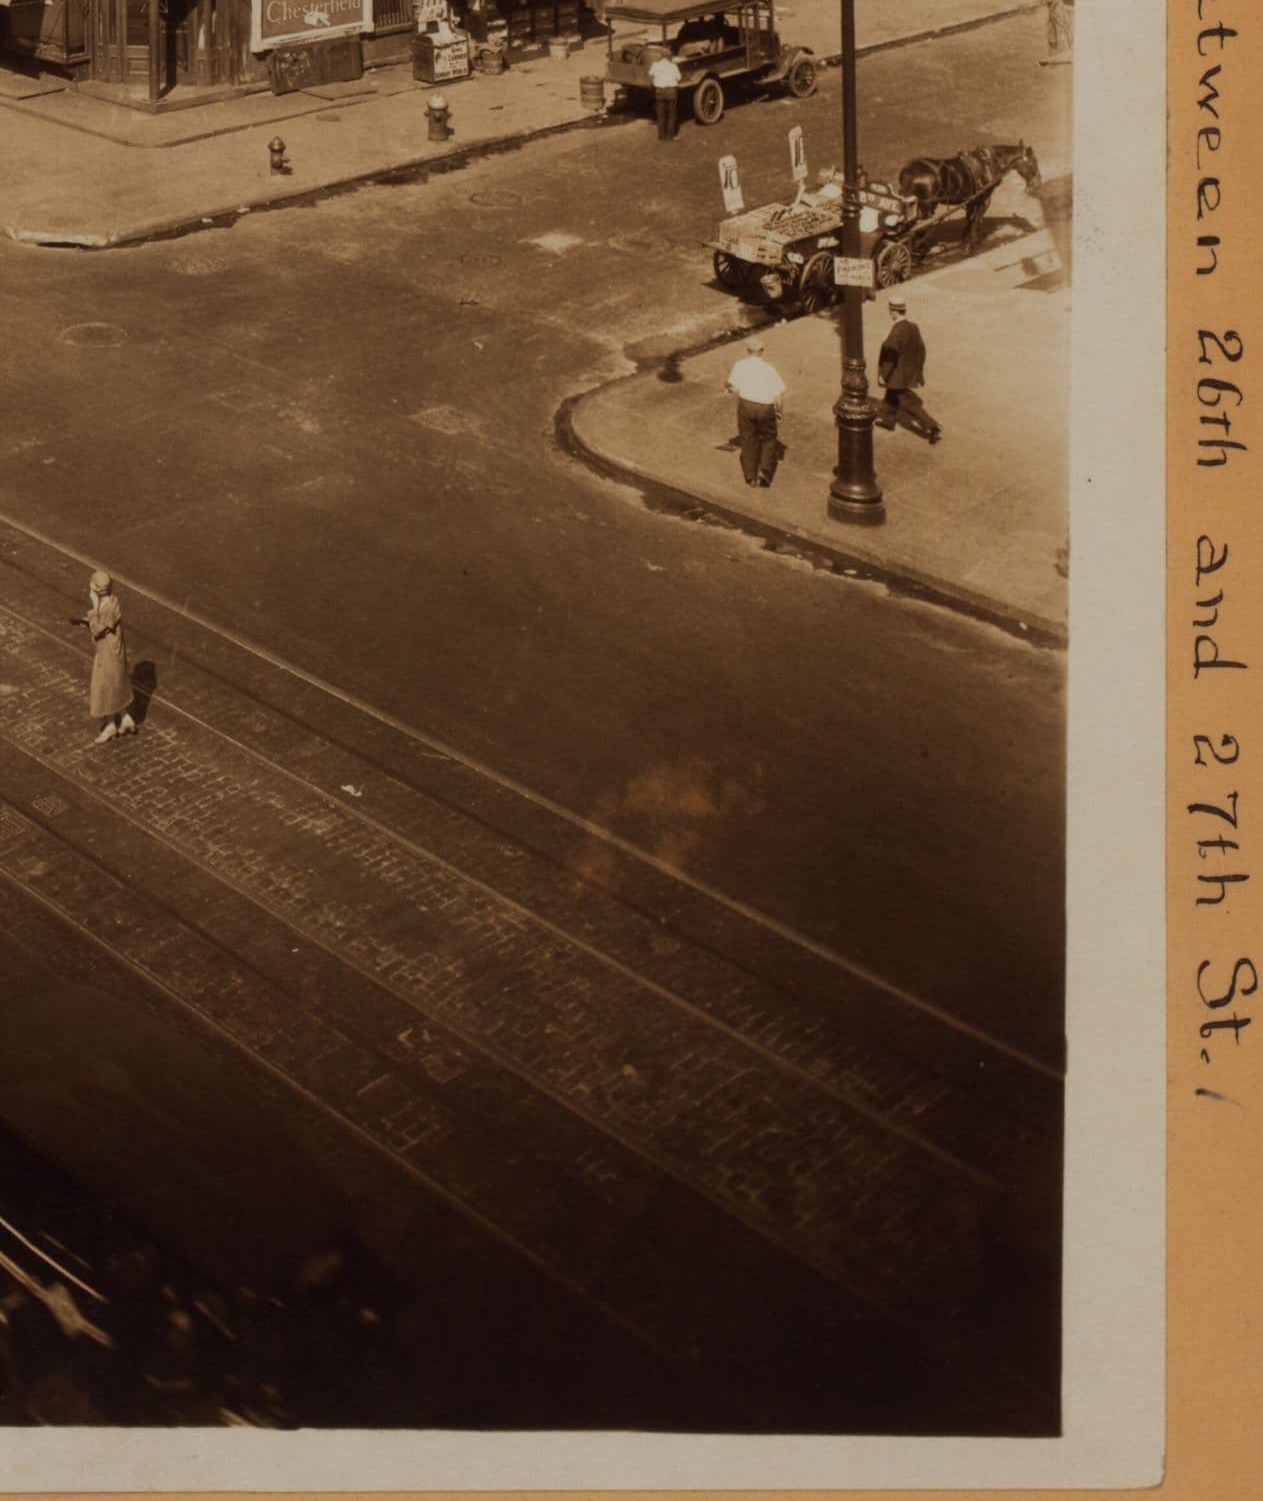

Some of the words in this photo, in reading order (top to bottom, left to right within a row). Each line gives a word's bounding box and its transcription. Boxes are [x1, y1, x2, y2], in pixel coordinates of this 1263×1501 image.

[1194, 330, 1243, 467] 26th
[1192, 536, 1245, 677] and
[1190, 734, 1243, 905] 27th
